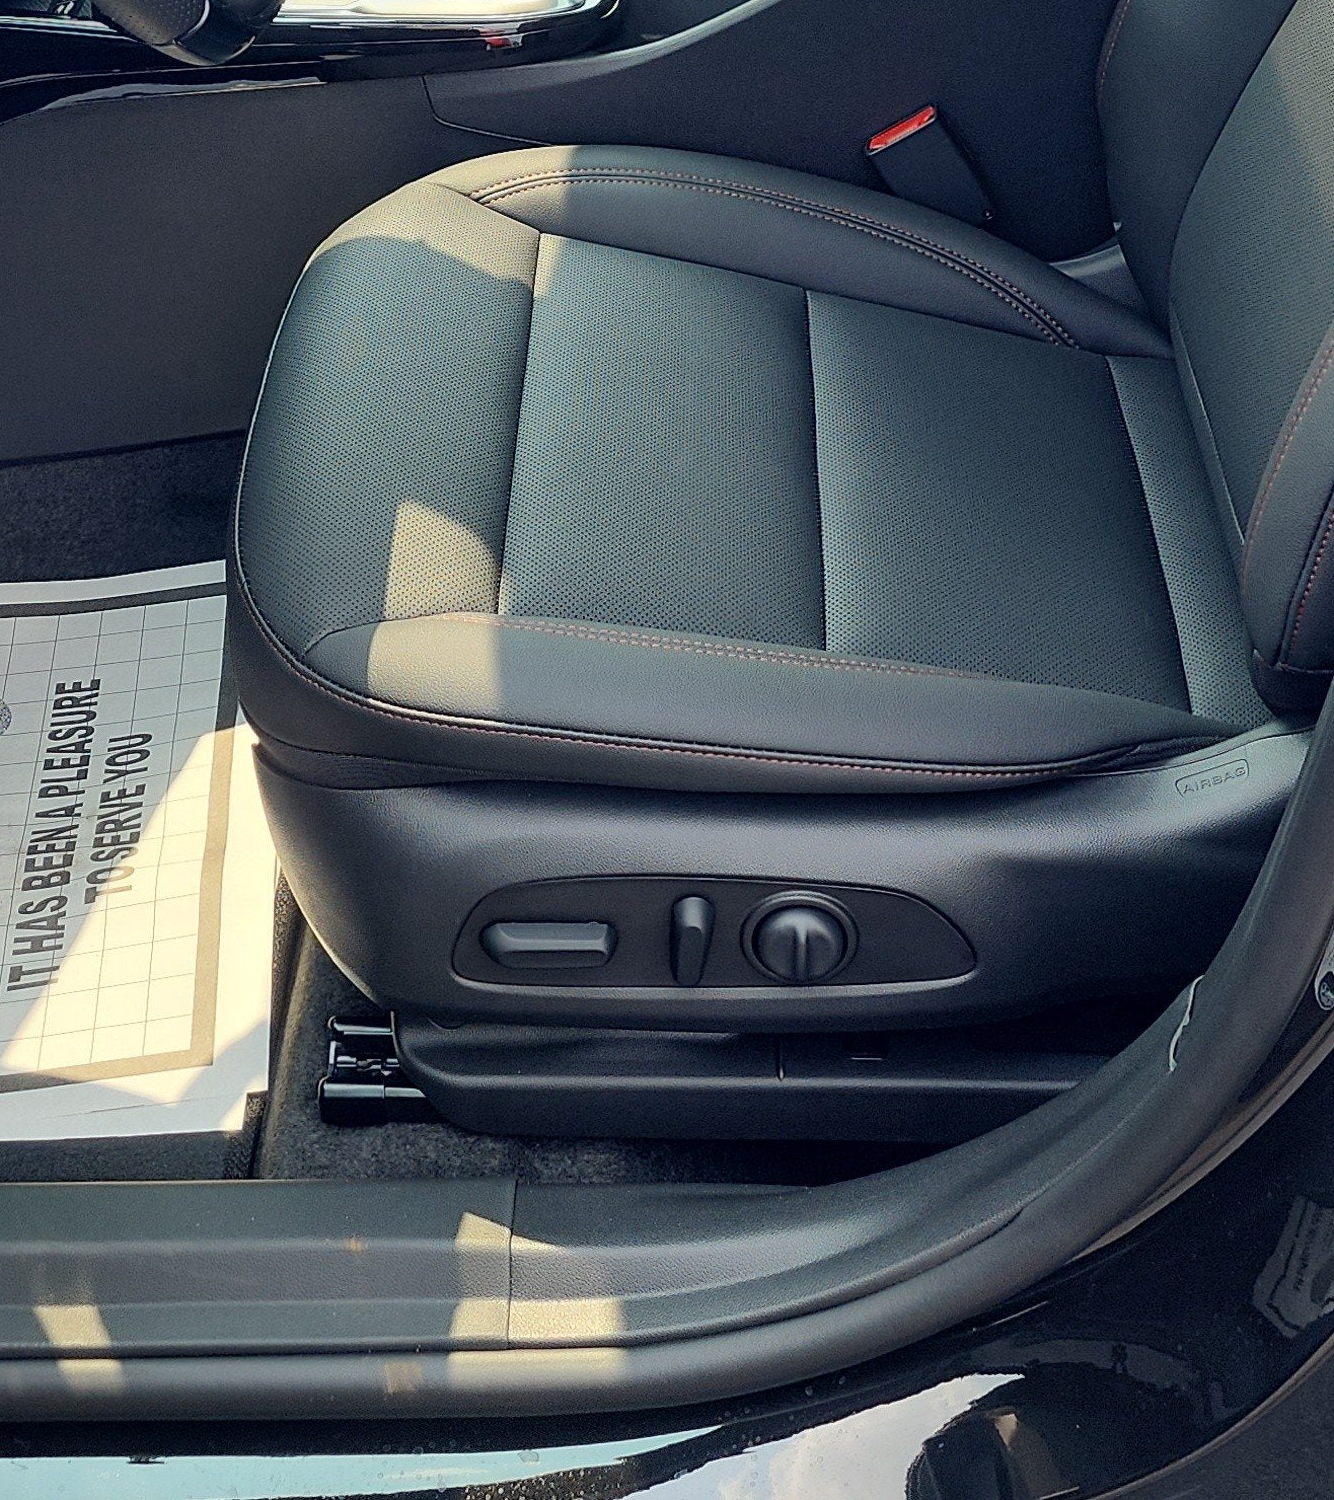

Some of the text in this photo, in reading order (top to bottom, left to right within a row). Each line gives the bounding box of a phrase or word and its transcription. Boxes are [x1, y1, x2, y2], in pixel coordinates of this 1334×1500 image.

[7, 678, 101, 991] IT HAS BEEN A PLEASURE
[84, 733, 153, 905] TO SERVE YOU
[1183, 766, 1246, 794] AIRBAG
